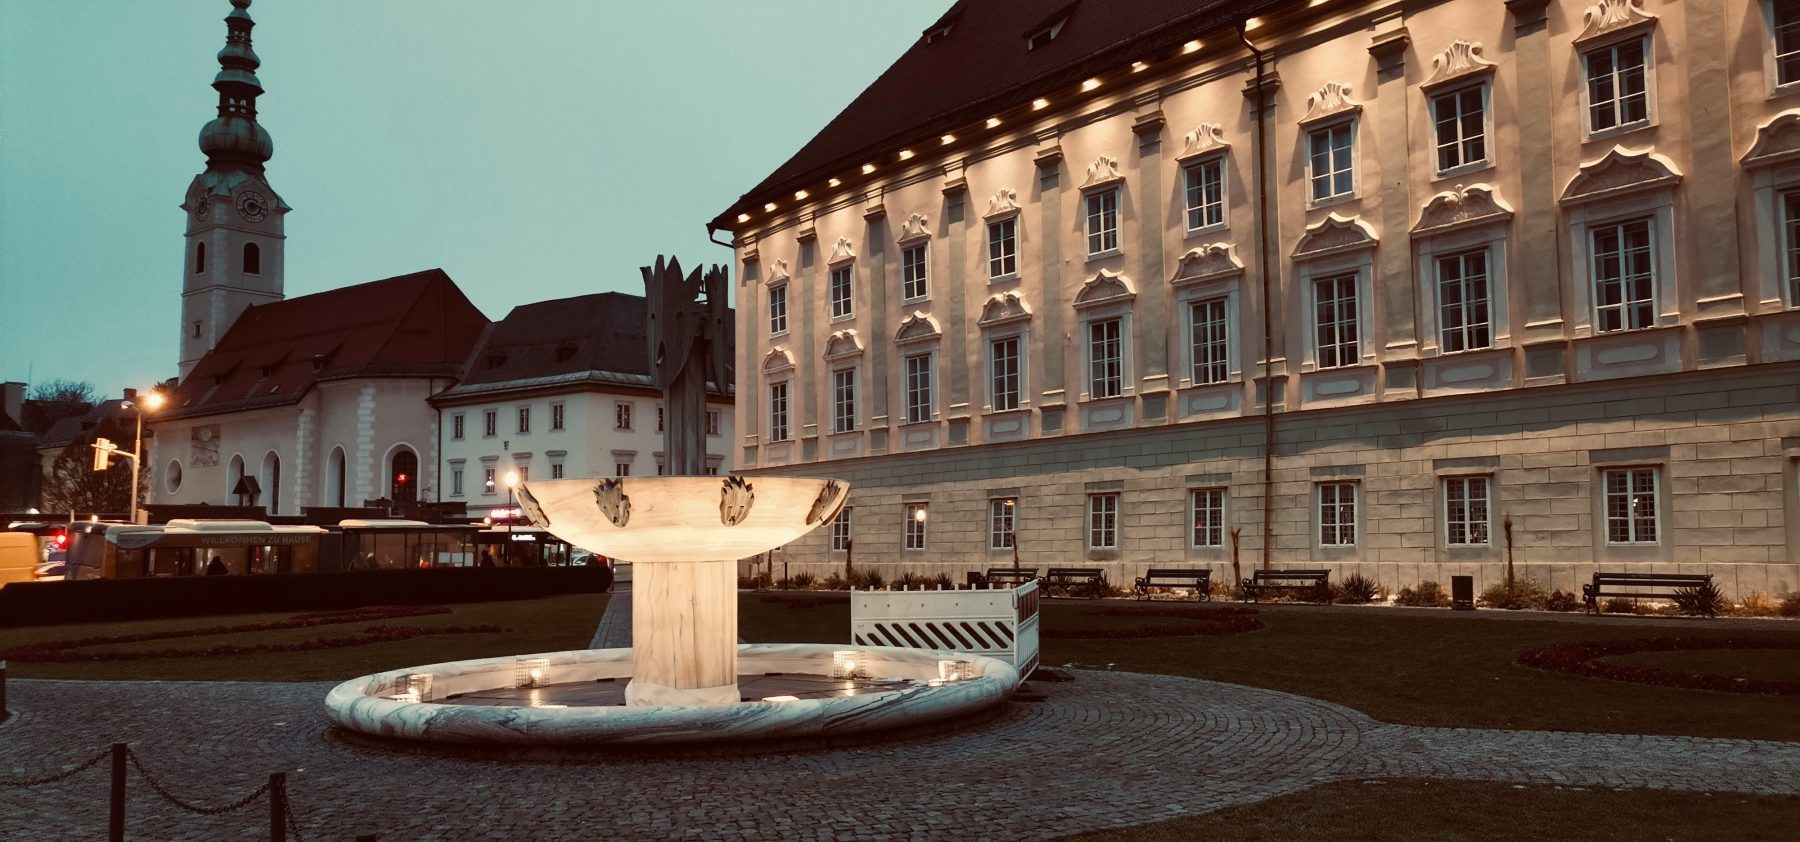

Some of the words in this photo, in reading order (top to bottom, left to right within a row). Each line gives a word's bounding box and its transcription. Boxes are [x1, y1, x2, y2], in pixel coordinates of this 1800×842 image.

[200, 535, 266, 544] WILLKOMMEN
[268, 535, 280, 544] ZU
[282, 535, 311, 544] HAUSE
